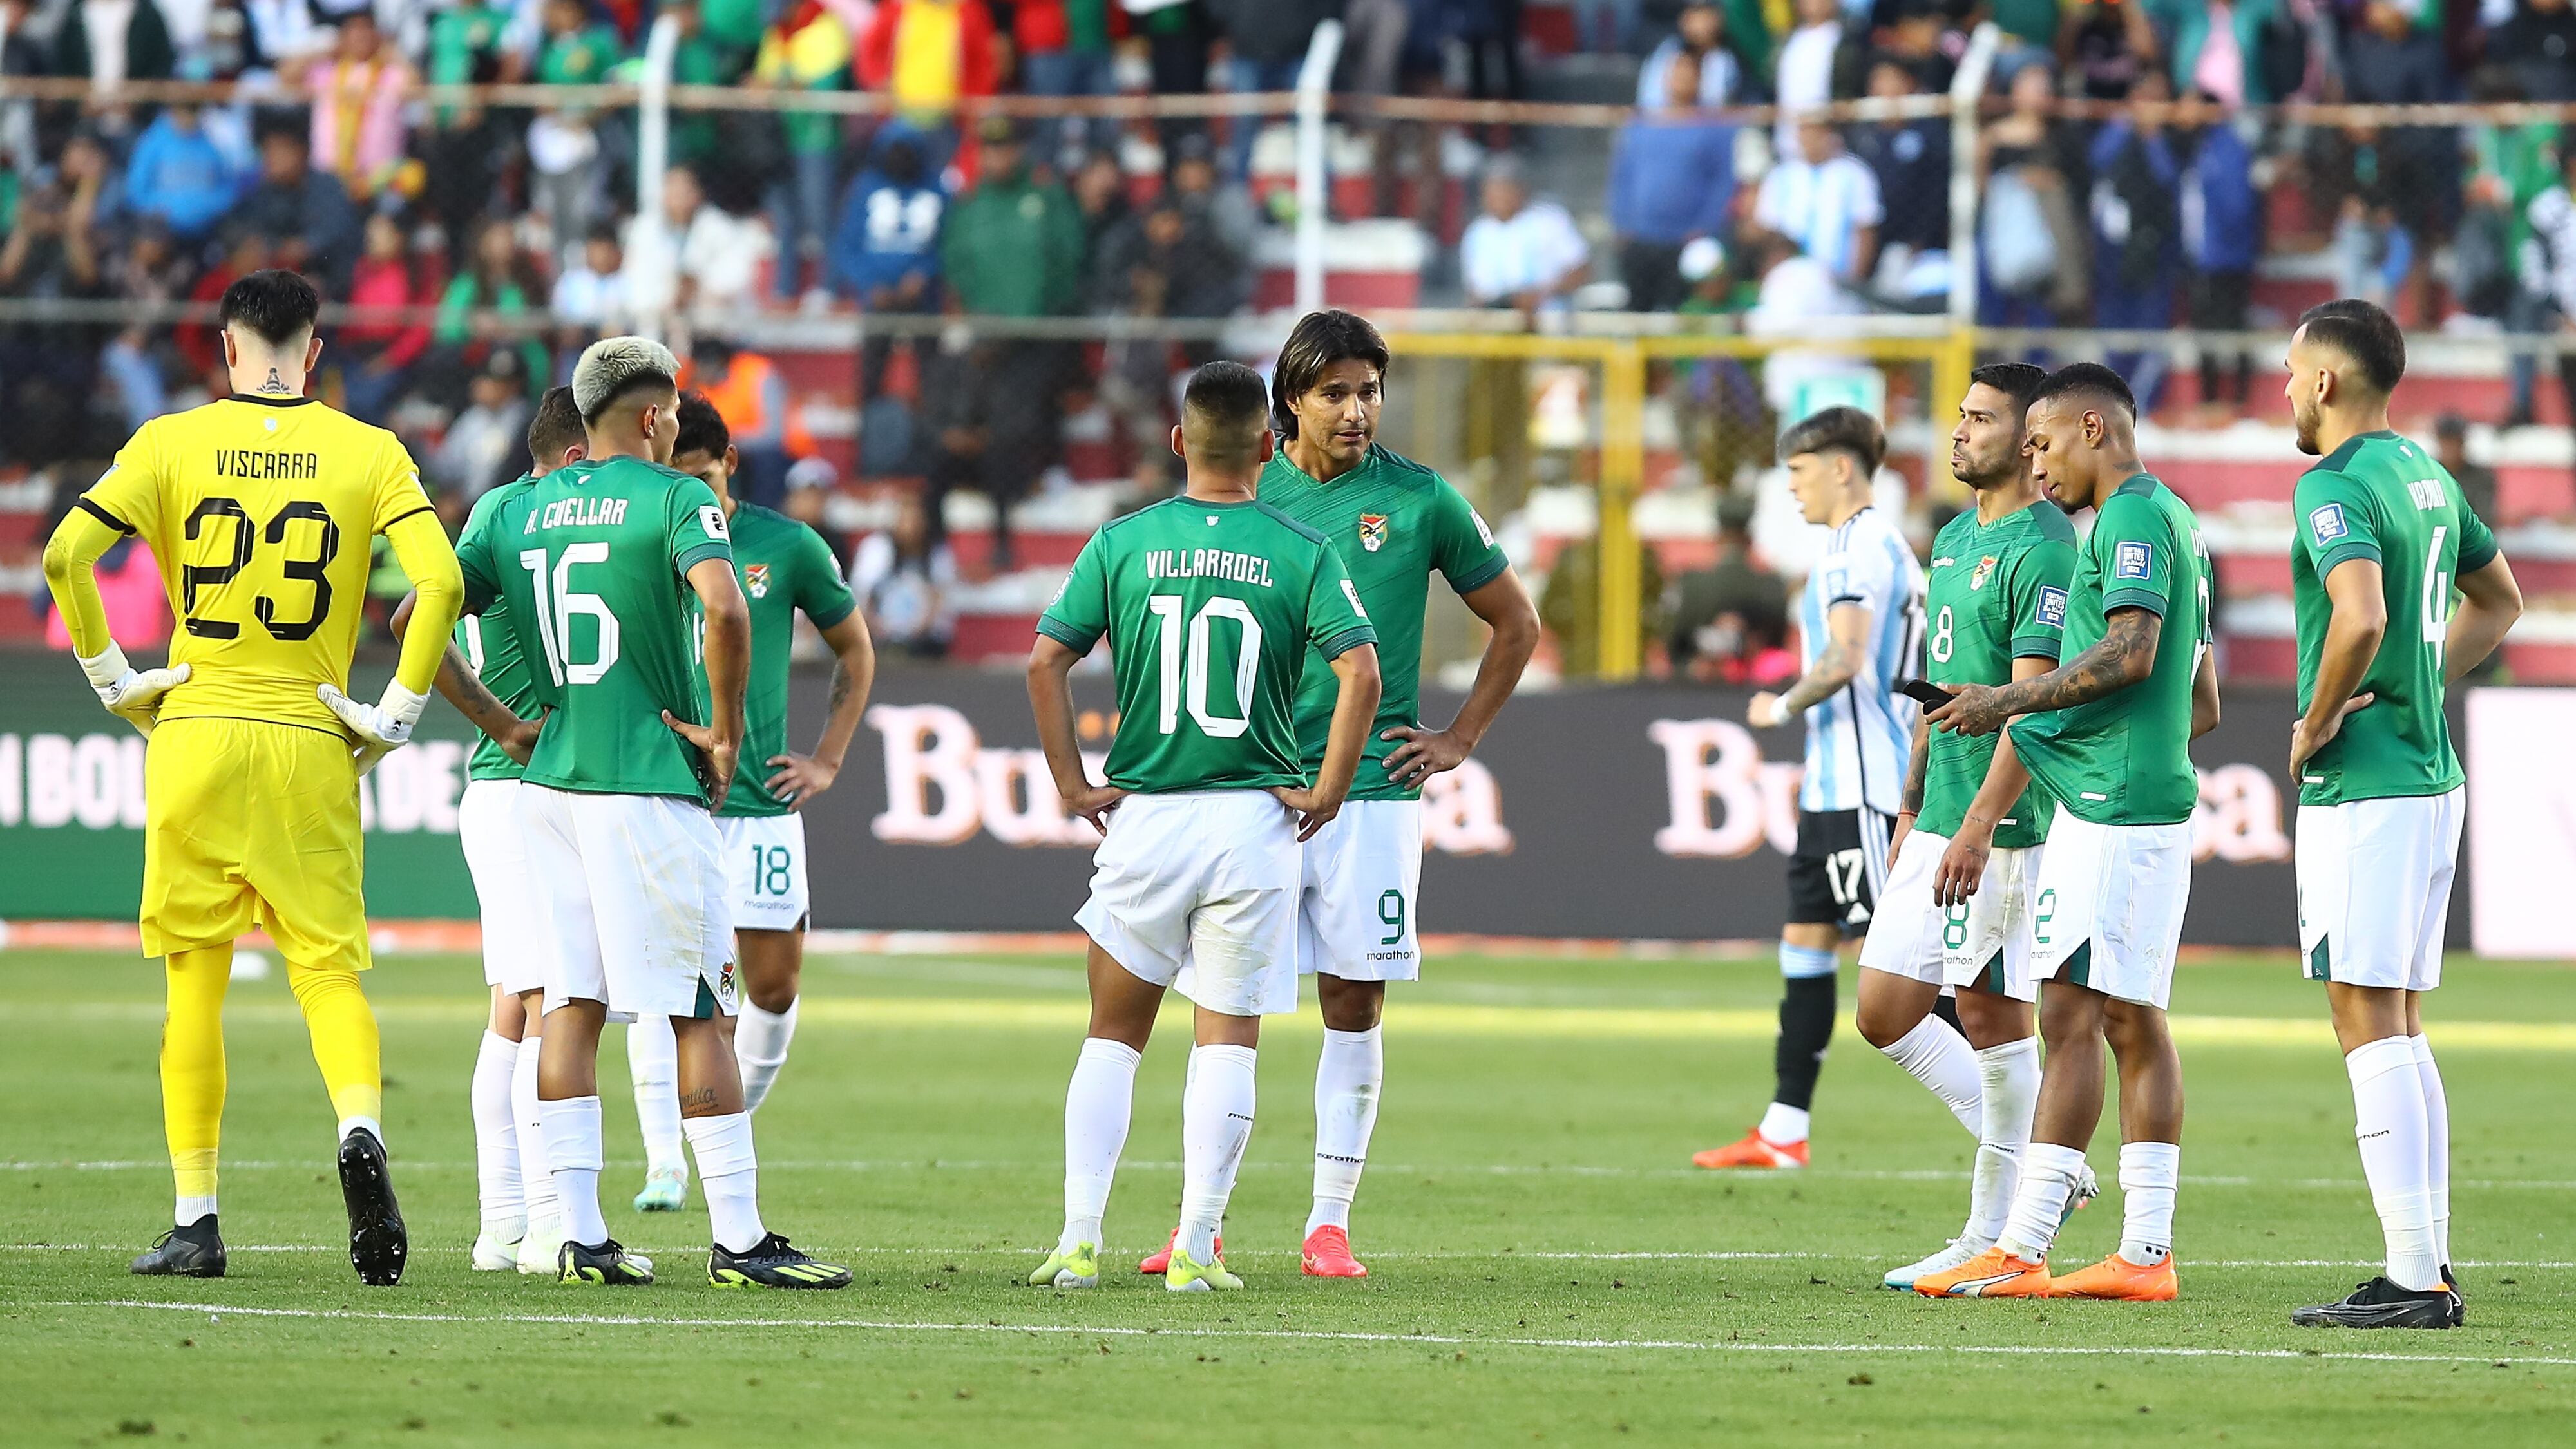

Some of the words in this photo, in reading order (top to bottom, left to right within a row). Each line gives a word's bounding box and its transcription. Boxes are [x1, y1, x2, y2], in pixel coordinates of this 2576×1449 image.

[216, 449, 317, 480] VISCARRA
[542, 497, 629, 530] CUELLAR
[182, 497, 340, 641] 23
[1146, 549, 1274, 588] VILLARROEL
[519, 542, 620, 687] 16
[2422, 526, 2448, 671] 4
[1931, 605, 1954, 663] 8
[1149, 594, 1263, 739] 10
[752, 844, 791, 895] 18
[1824, 848, 1865, 905] 17
[1378, 889, 1405, 945] 9
[1943, 894, 1970, 950] 8
[2034, 888, 2057, 944] 2
[1366, 949, 1415, 961] marathon
